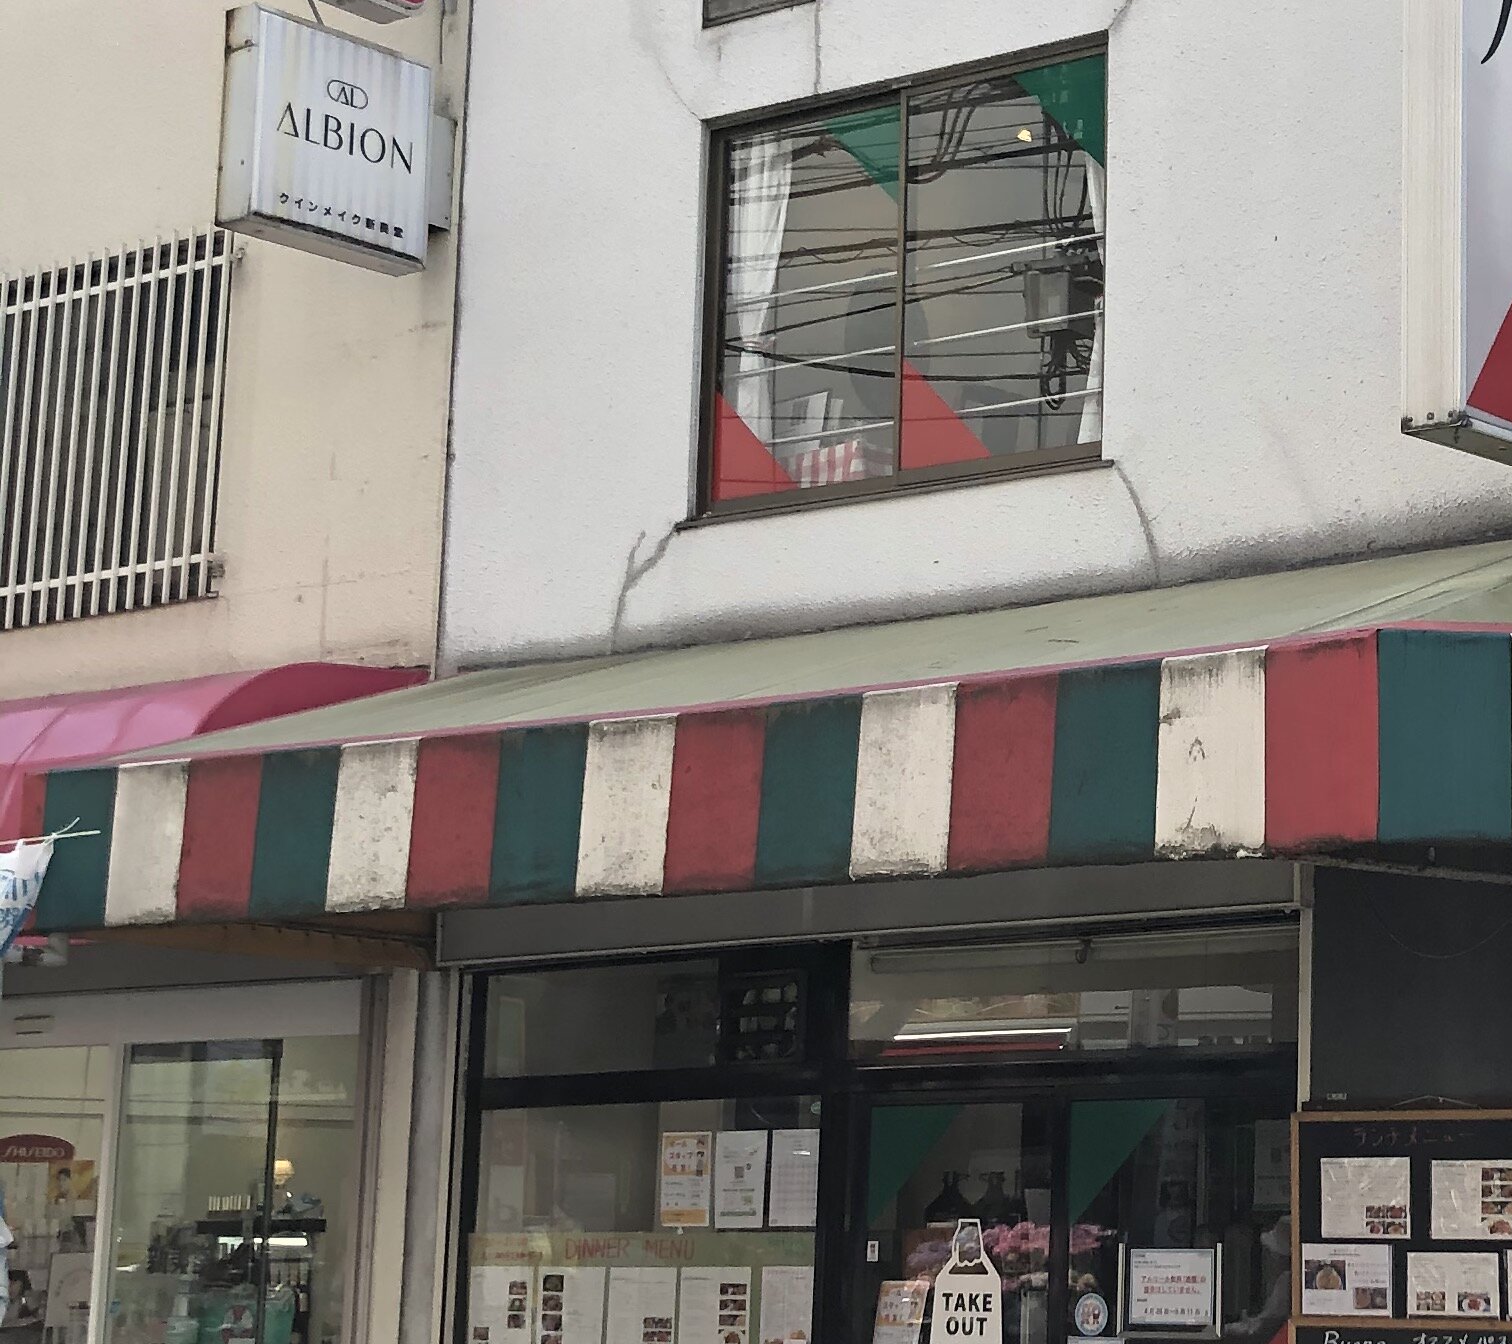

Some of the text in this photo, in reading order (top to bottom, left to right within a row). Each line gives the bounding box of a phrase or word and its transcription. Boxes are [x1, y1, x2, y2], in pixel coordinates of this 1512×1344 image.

[276, 102, 414, 174] ALBION
[565, 1238, 630, 1260] DINNER
[643, 1239, 695, 1261] MENU
[942, 1292, 993, 1313] TAKE
[945, 1317, 988, 1336] OUT
